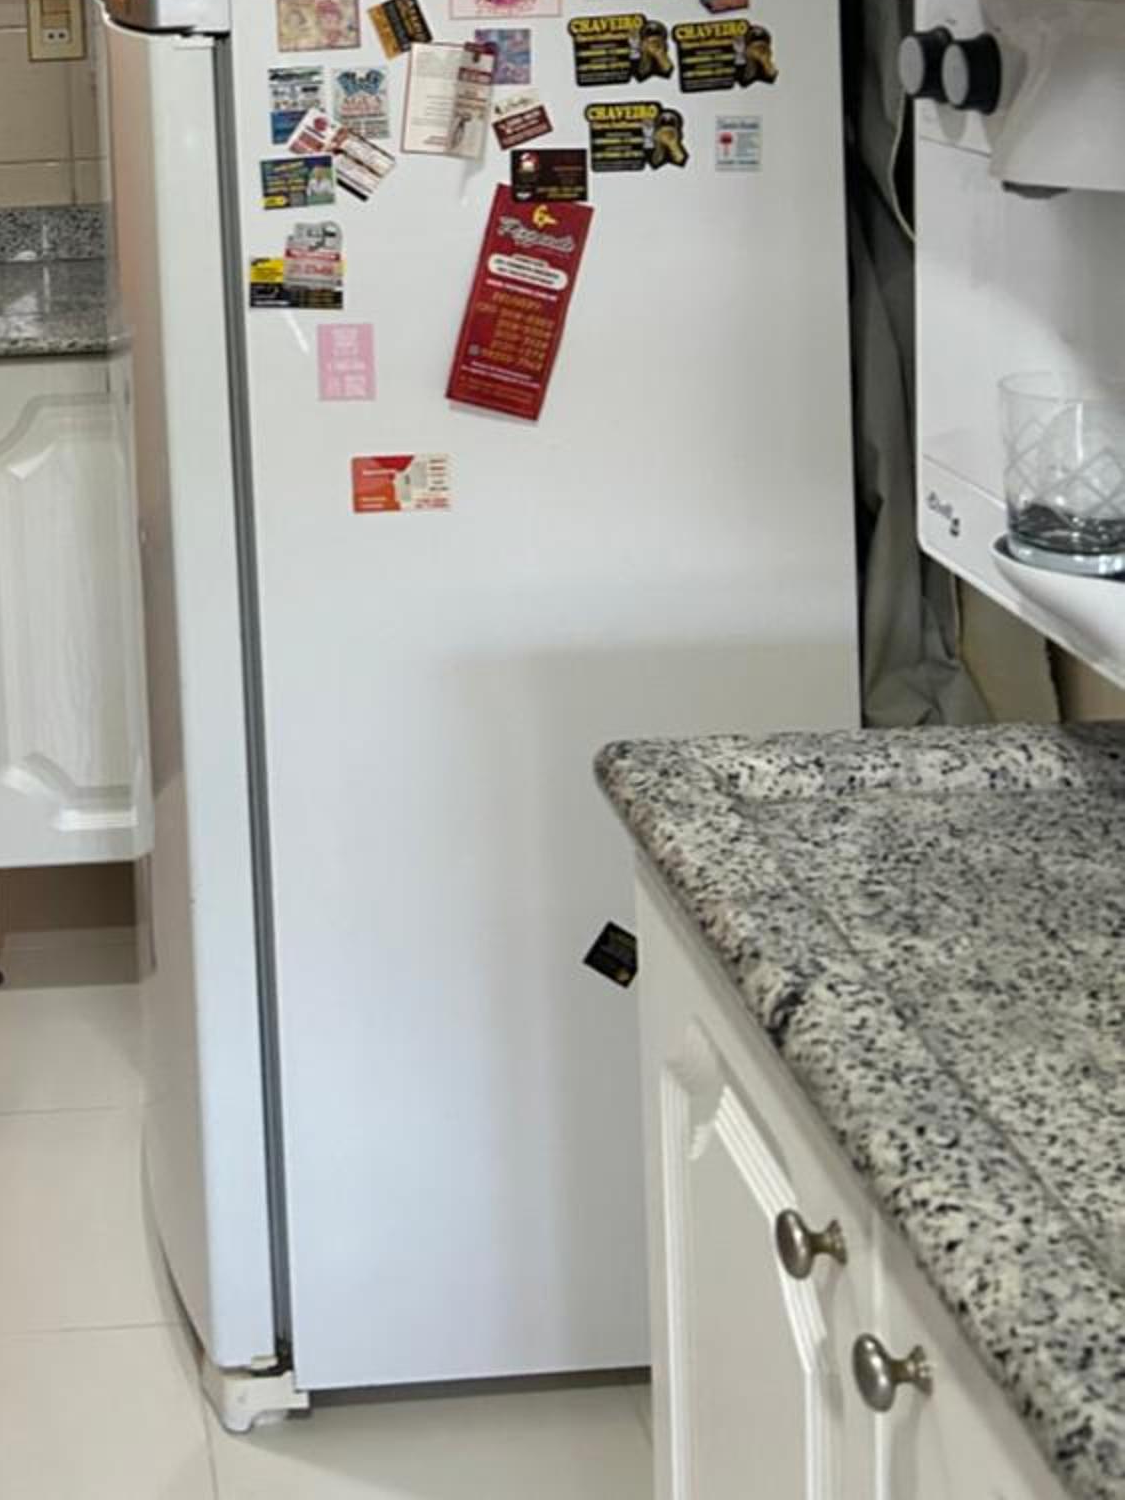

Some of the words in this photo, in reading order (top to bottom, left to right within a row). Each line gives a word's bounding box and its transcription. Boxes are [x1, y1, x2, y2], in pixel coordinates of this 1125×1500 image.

[571, 15, 643, 35] CHAVEIRO
[676, 20, 747, 40] CHAVEIRO
[588, 103, 659, 121] CHAVEIRO
